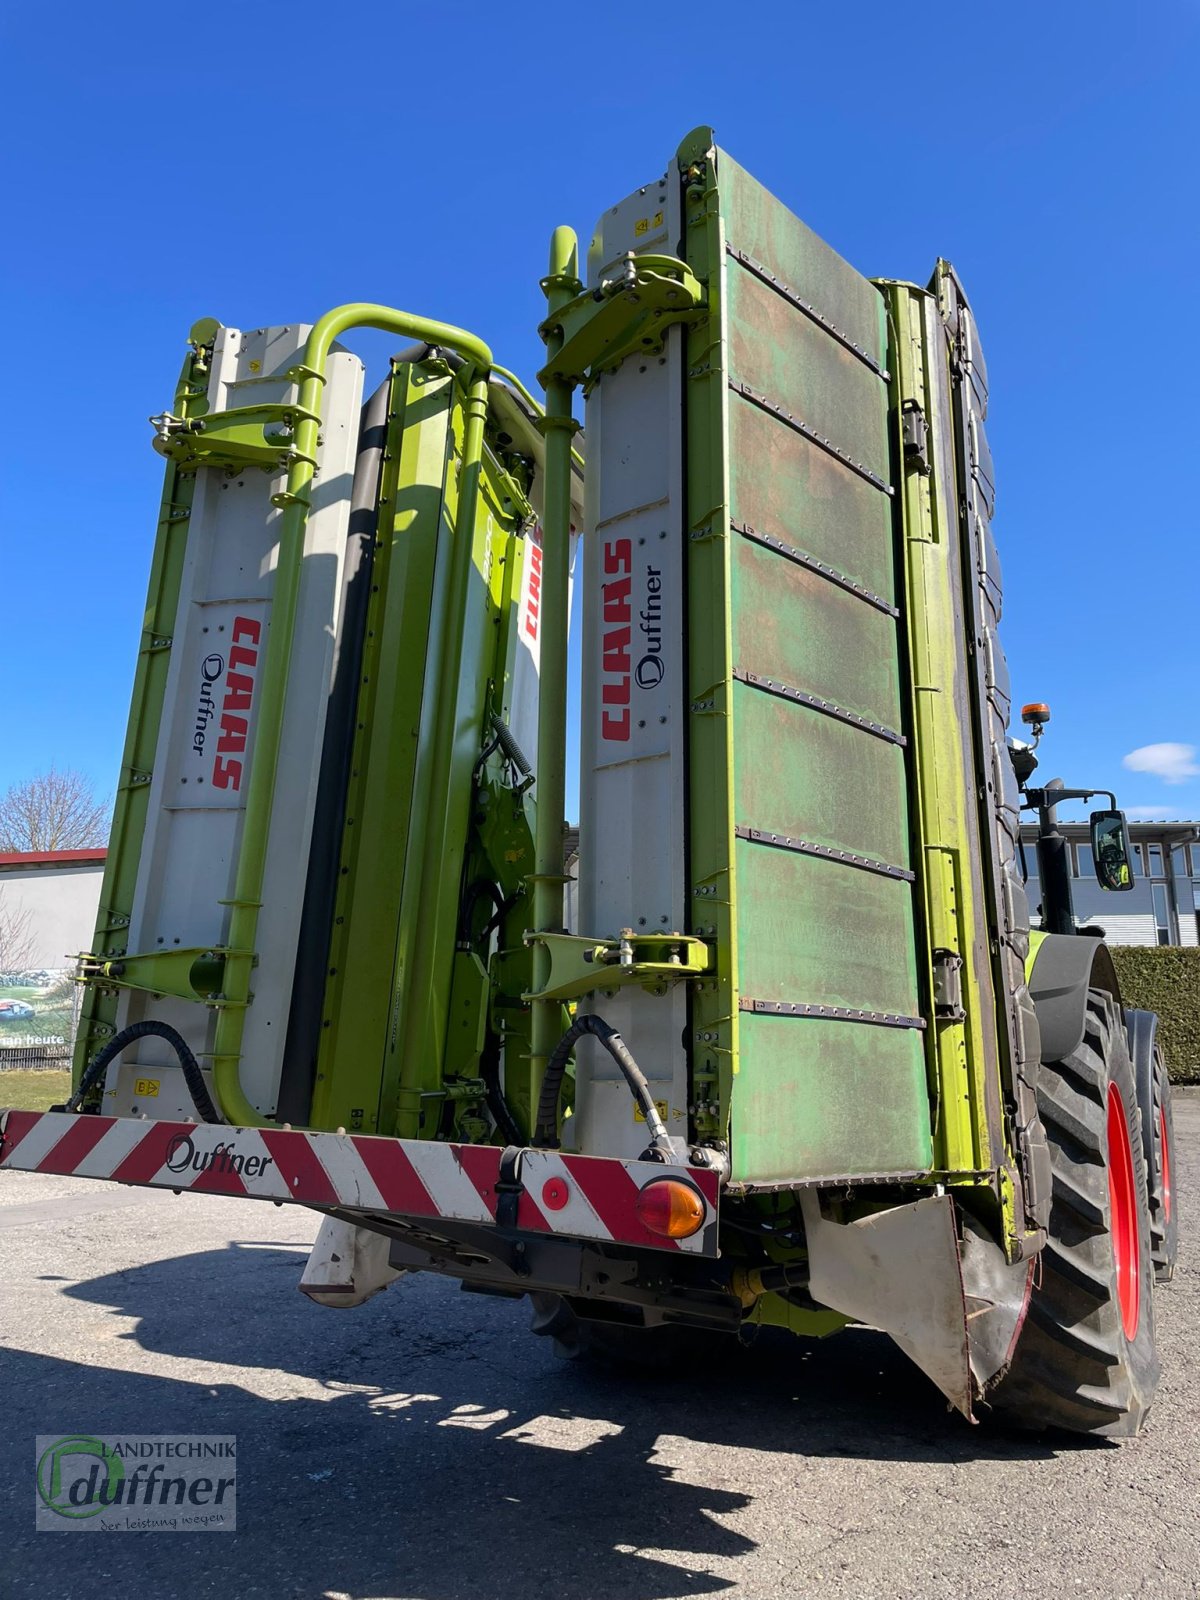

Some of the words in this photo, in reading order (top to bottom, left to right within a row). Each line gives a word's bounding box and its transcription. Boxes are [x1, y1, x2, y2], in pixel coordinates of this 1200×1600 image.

[602, 538, 632, 742] CLAAS
[634, 565, 665, 690] Duffner
[192, 653, 225, 757] Duffner
[212, 616, 261, 791] CLAAS
[26, 1033, 65, 1045] heute
[166, 1132, 273, 1177] Duffner
